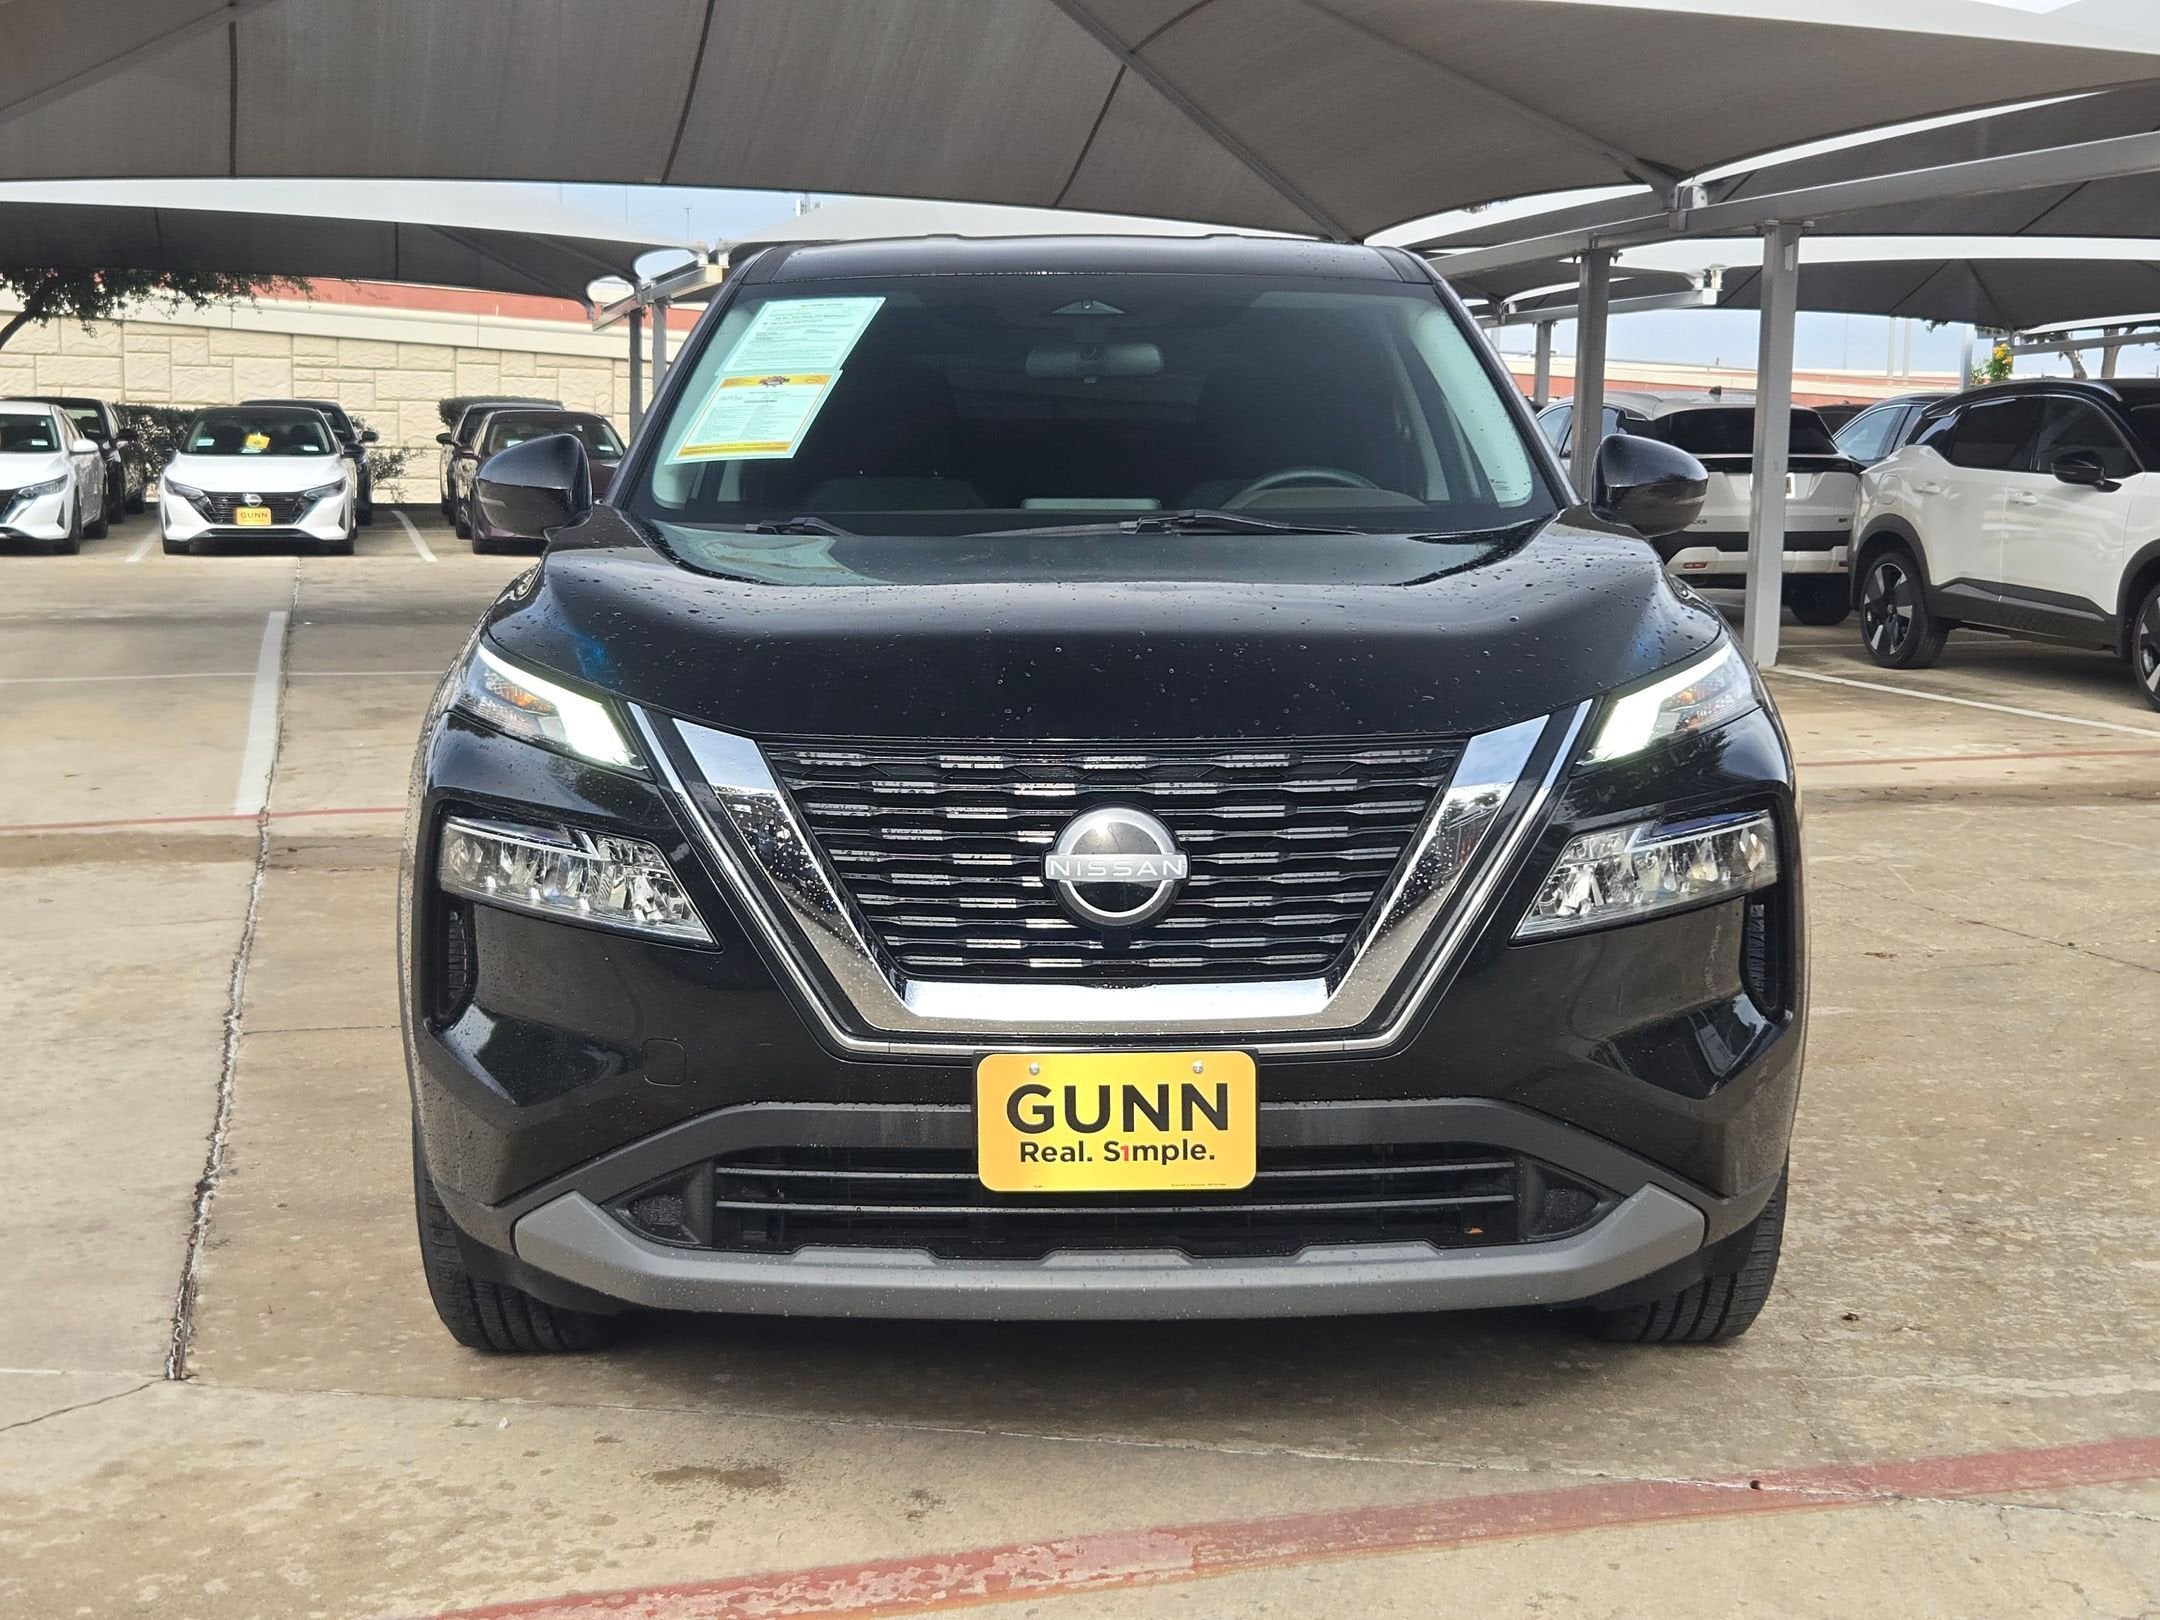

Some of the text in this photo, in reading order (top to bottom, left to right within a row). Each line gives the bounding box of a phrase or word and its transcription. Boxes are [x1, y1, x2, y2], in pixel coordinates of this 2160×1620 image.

[1050, 860, 1182, 877] NISSAN
[1006, 1082, 1229, 1135] GUNN
[1020, 1140, 1093, 1163] Real.
